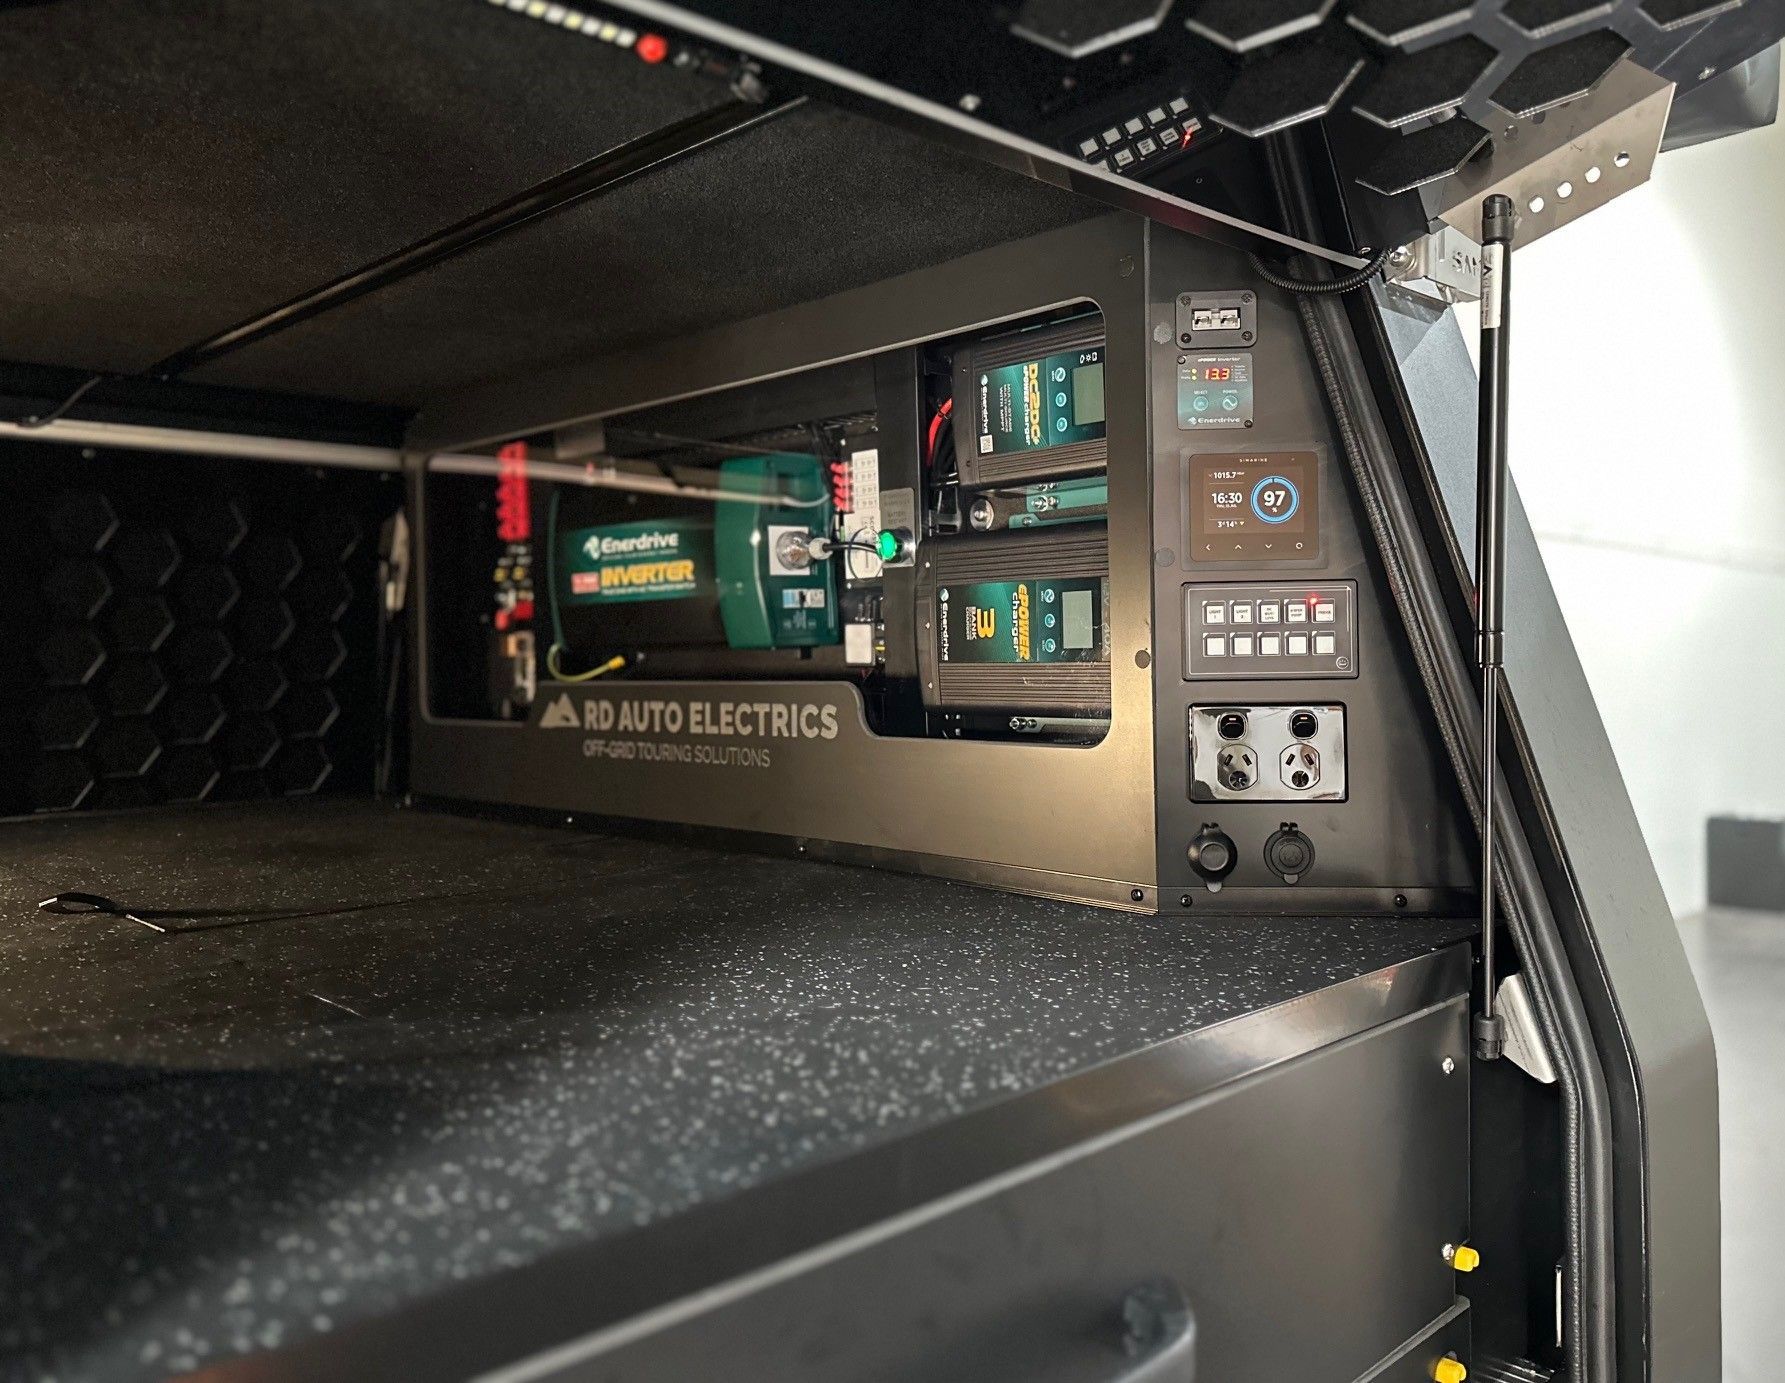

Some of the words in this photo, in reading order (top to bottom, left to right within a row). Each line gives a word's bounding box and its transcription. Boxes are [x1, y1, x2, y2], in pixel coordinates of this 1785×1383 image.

[1197, 416, 1240, 424] Enerdrive
[1213, 471, 1237, 479] 1015.7
[1211, 492, 1243, 504] 16:30
[1263, 490, 1286, 507] 97
[601, 532, 679, 554] Enerdrive
[601, 559, 695, 587] INVERTER
[976, 608, 995, 639] 3
[1011, 592, 1020, 653] charger
[1018, 584, 1030, 661] ePOWER
[584, 700, 615, 731] RD
[617, 701, 683, 734] AUTO
[689, 702, 839, 740] ELECTRICS
[583, 739, 635, 759] OFF-GRID
[637, 742, 692, 763] TOURING
[694, 745, 771, 768] SOLUTIONS
